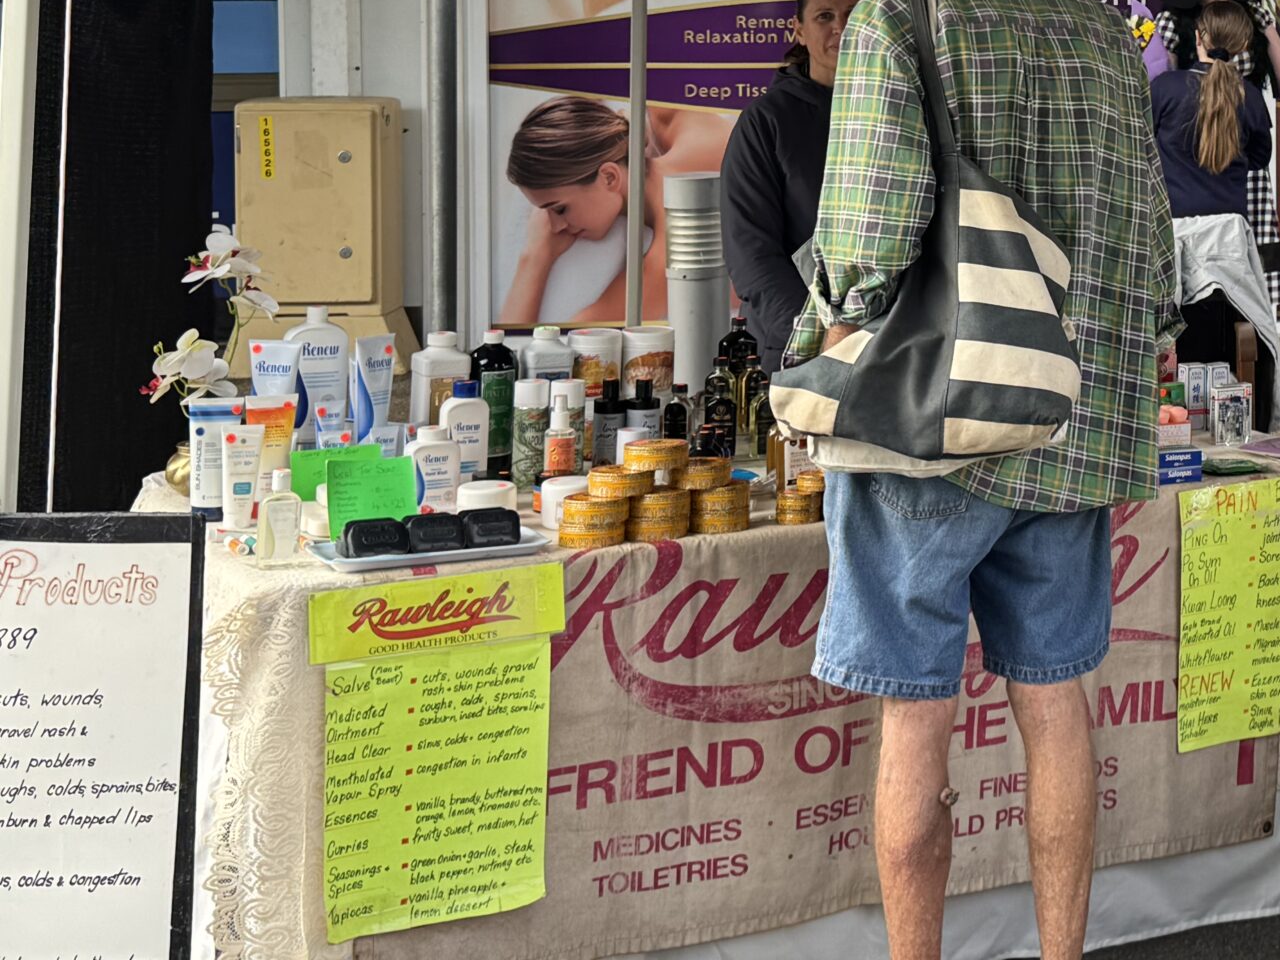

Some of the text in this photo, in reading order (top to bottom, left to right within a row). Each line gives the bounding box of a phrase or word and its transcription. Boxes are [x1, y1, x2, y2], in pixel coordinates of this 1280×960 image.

[684, 30, 778, 44] Relaxation
[684, 83, 731, 101] Deep
[262, 117, 273, 178] 165626
[302, 342, 339, 357] Renew
[255, 360, 291, 375] Renew
[365, 356, 392, 370] Renew
[454, 422, 480, 433] Renew
[422, 453, 449, 464] Renew
[1165, 453, 1191, 463] Salonpas
[1167, 469, 1192, 479] Salonpas
[1215, 488, 1258, 515] PAIN
[1184, 528, 1209, 546] PING
[0, 548, 158, 606] Products
[347, 581, 521, 640] Rawleigh
[1182, 591, 1237, 613] Kwan Loong
[368, 630, 498, 655] GOOD HEALTH PRODUCTS
[331, 675, 370, 697] Salve
[1180, 670, 1235, 699] RENEW
[41, 688, 104, 709] wounds,
[326, 703, 388, 725] Medicated
[41, 720, 76, 737] rash
[326, 722, 383, 744] Ointment
[477, 726, 530, 743] congestion
[26, 753, 97, 773] problems
[327, 742, 391, 766] Head Clear
[416, 758, 467, 776] congestion
[547, 718, 874, 816] FRIEND OF
[46, 776, 177, 799] colds, sprains, bites,
[326, 766, 393, 790] Mentholated
[325, 783, 403, 806] Vapour Spray
[43, 806, 154, 829] & chapped lips
[324, 808, 379, 829] Essences
[326, 838, 369, 859] Curries
[592, 818, 742, 862] MEDICINES
[17, 870, 54, 888] colds
[57, 878, 64, 887] &
[69, 868, 142, 893] congestion
[327, 865, 382, 884] Seasonings
[592, 853, 748, 897] TOILETRIES
[328, 880, 364, 899] Spices
[447, 881, 498, 900] pineapple
[328, 904, 374, 928] Tapiocas
